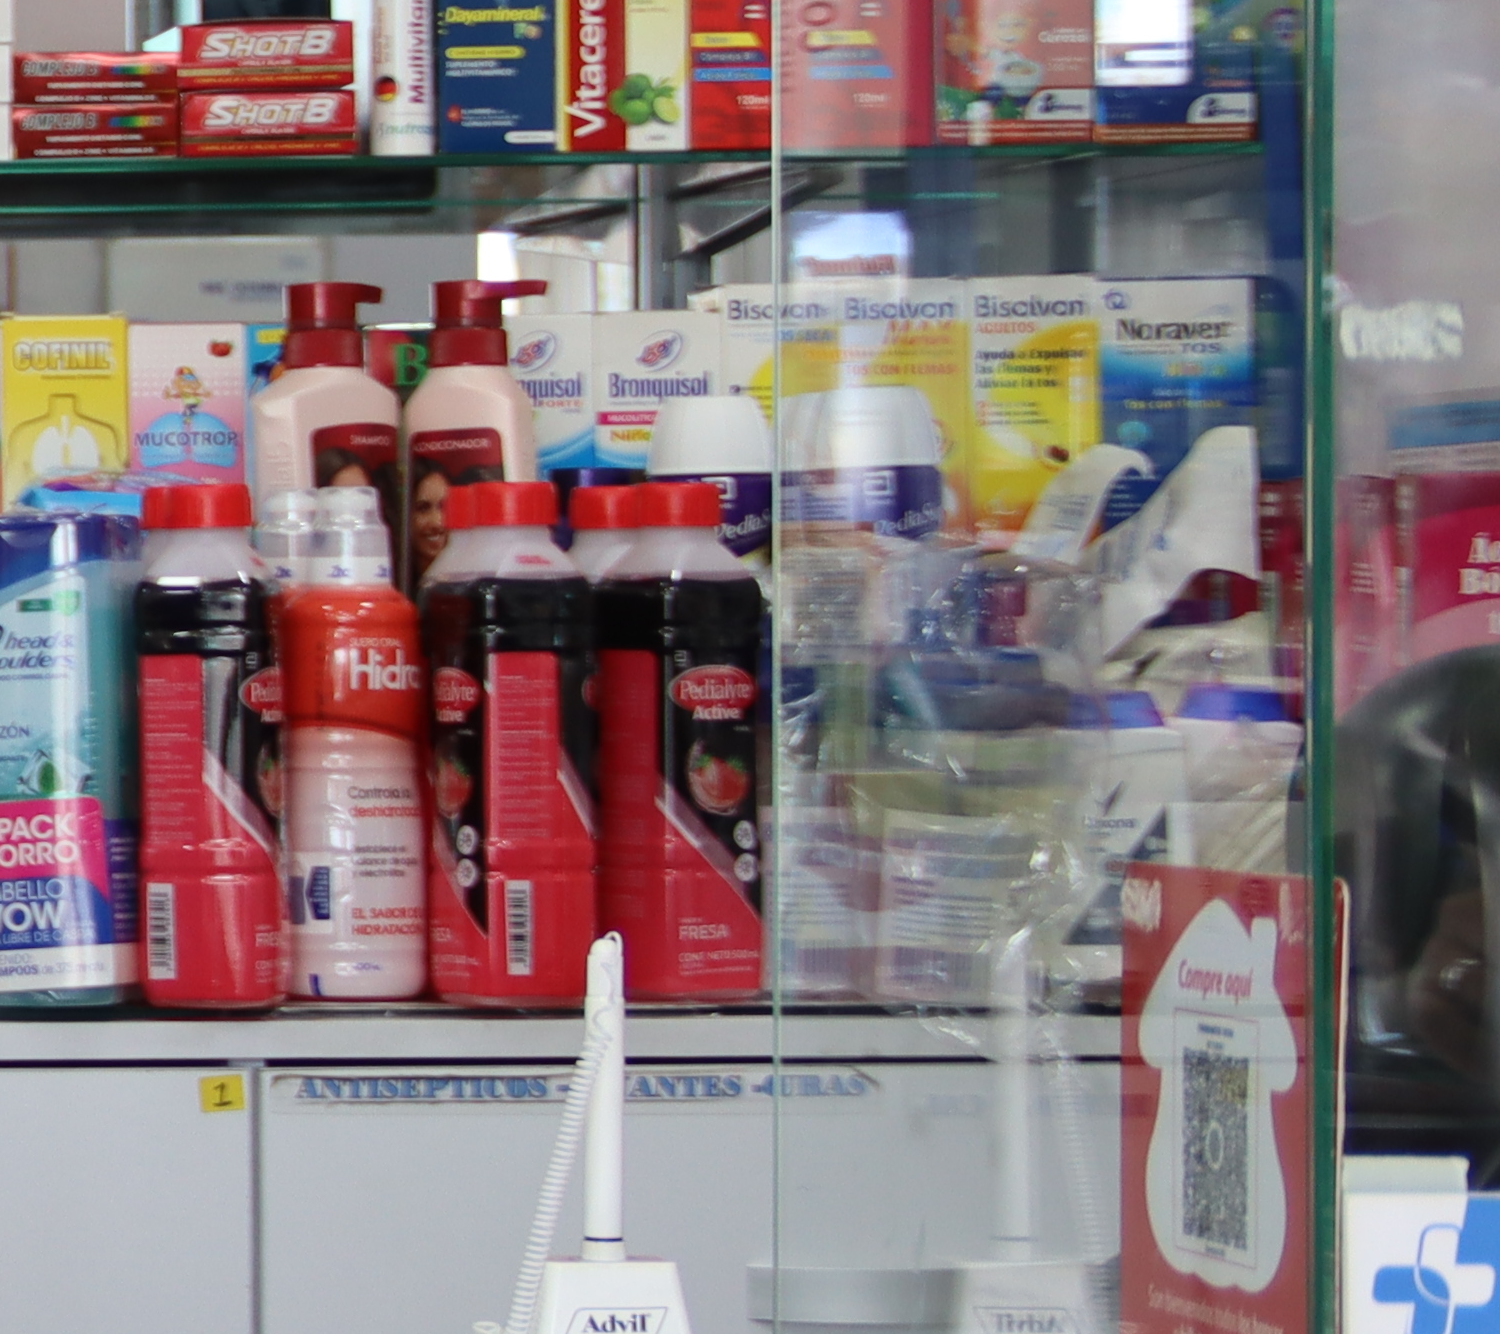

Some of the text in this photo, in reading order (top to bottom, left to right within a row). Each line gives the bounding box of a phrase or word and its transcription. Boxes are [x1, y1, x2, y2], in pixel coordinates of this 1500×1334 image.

[134, 431, 239, 451] MUCOTROP
[678, 678, 755, 703] Pedialyte
[678, 922, 730, 941] FRESA
[1178, 958, 1252, 999] Compre aquí
[293, 1077, 548, 1102] ANTISEPTICOS
[582, 1314, 648, 1333] Advil
